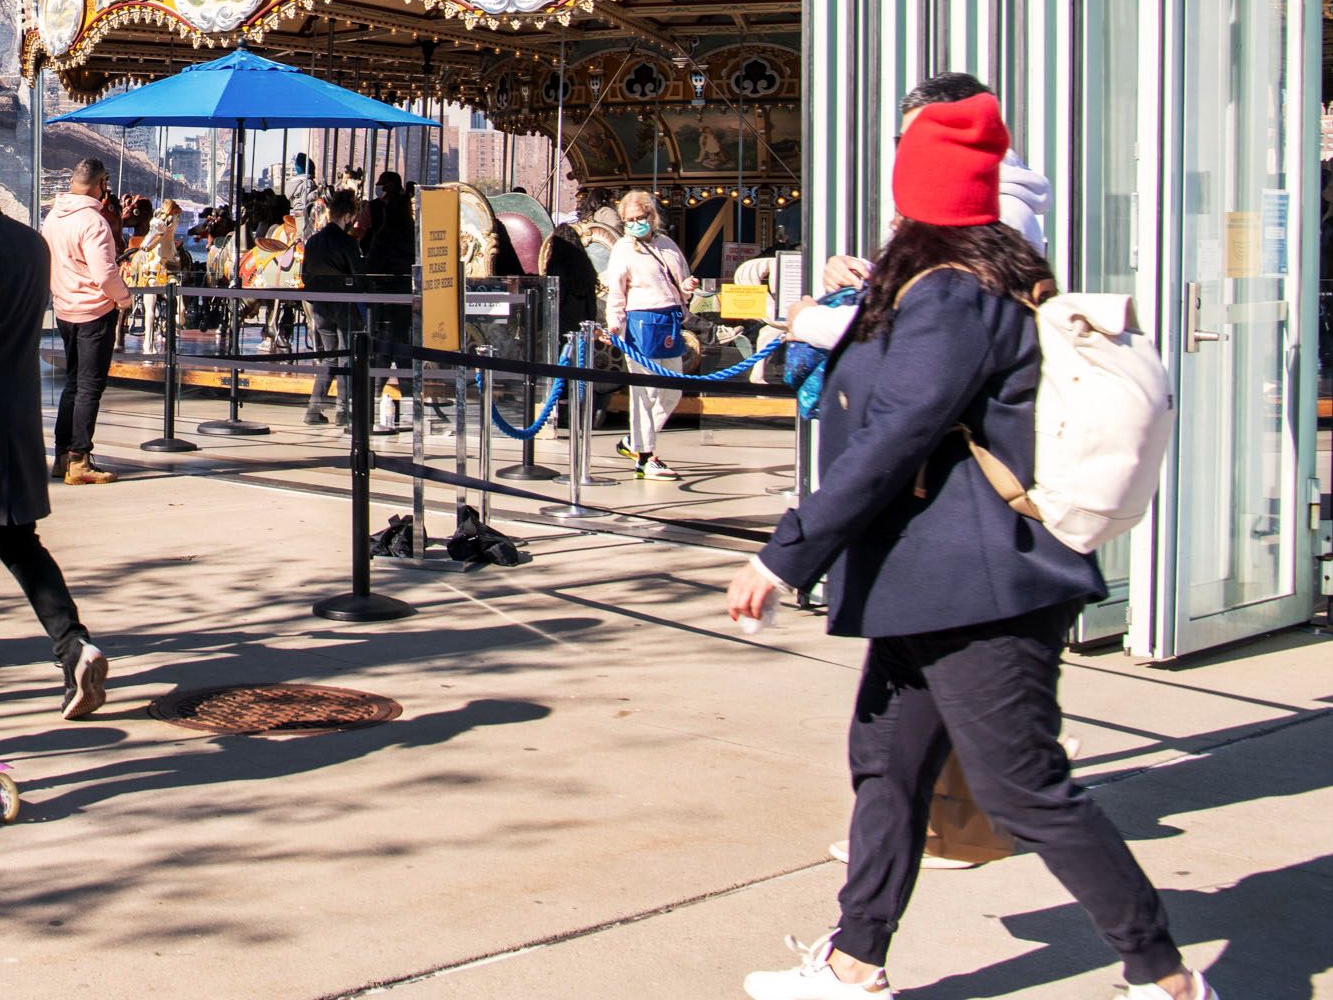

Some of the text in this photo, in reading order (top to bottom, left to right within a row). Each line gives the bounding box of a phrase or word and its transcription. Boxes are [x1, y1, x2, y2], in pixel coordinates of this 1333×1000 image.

[429, 230, 446, 241] TICKET
[427, 246, 448, 258] HOLDERS
[428, 262, 447, 274] PLEASE
[441, 277, 453, 289] HERE
